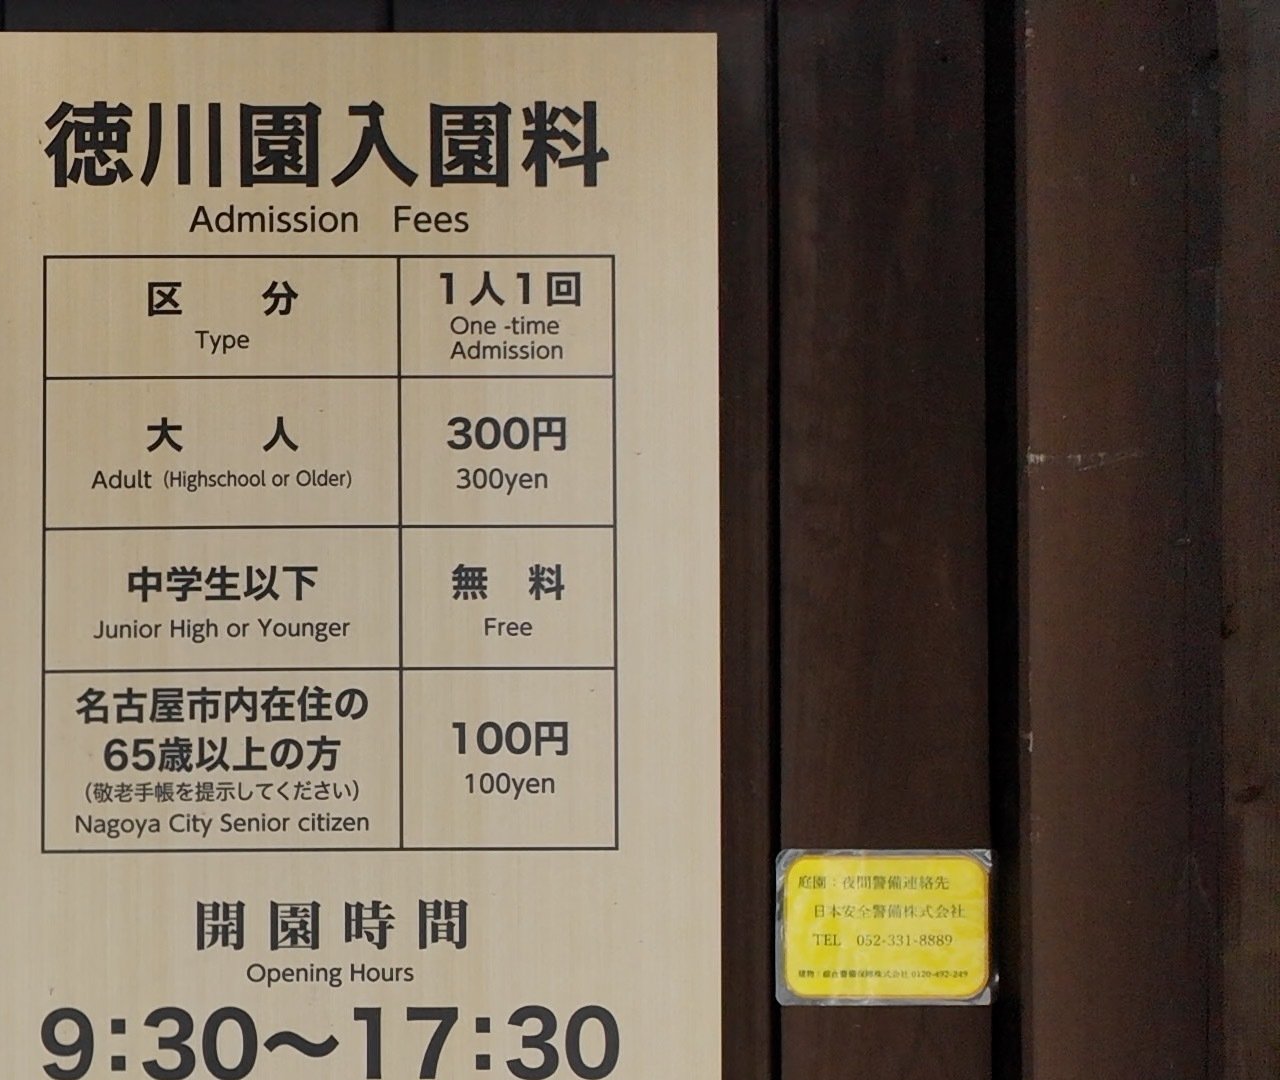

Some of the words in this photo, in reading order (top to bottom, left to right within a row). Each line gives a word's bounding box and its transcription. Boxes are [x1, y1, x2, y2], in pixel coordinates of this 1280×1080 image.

[43, 100, 610, 189] 徳川園入園料
[188, 204, 359, 233] Admission
[394, 205, 469, 233] Fees
[439, 270, 581, 307] 1人1回
[194, 330, 250, 355] Type
[449, 340, 563, 360] Admission
[446, 416, 567, 452] 300円
[91, 469, 153, 490] Adult
[163, 469, 266, 493] (Highschool
[271, 473, 291, 487] or
[295, 469, 352, 489] Older)
[456, 467, 548, 496] 300yen
[127, 564, 319, 603] 中学生以下
[93, 619, 163, 639] Junior
[170, 618, 219, 644] High
[226, 622, 250, 638] or
[257, 618, 351, 643] Younger
[484, 617, 533, 637] Free
[75, 685, 369, 725] 名古屋市内在住の
[103, 734, 342, 773] 65歳以上の方
[451, 721, 569, 757] 100円
[85, 779, 360, 804] (敬老手帳を提示してください)
[465, 772, 555, 801] 100yen
[75, 814, 161, 839] Nagoya
[168, 813, 213, 839] City
[220, 812, 291, 833] Senior
[297, 812, 370, 832] citizen
[196, 898, 469, 952] 開園時間
[812, 933, 841, 947] TEL
[856, 933, 954, 947] 052-331-8889
[246, 963, 343, 988] Opening
[350, 963, 415, 983] Hours
